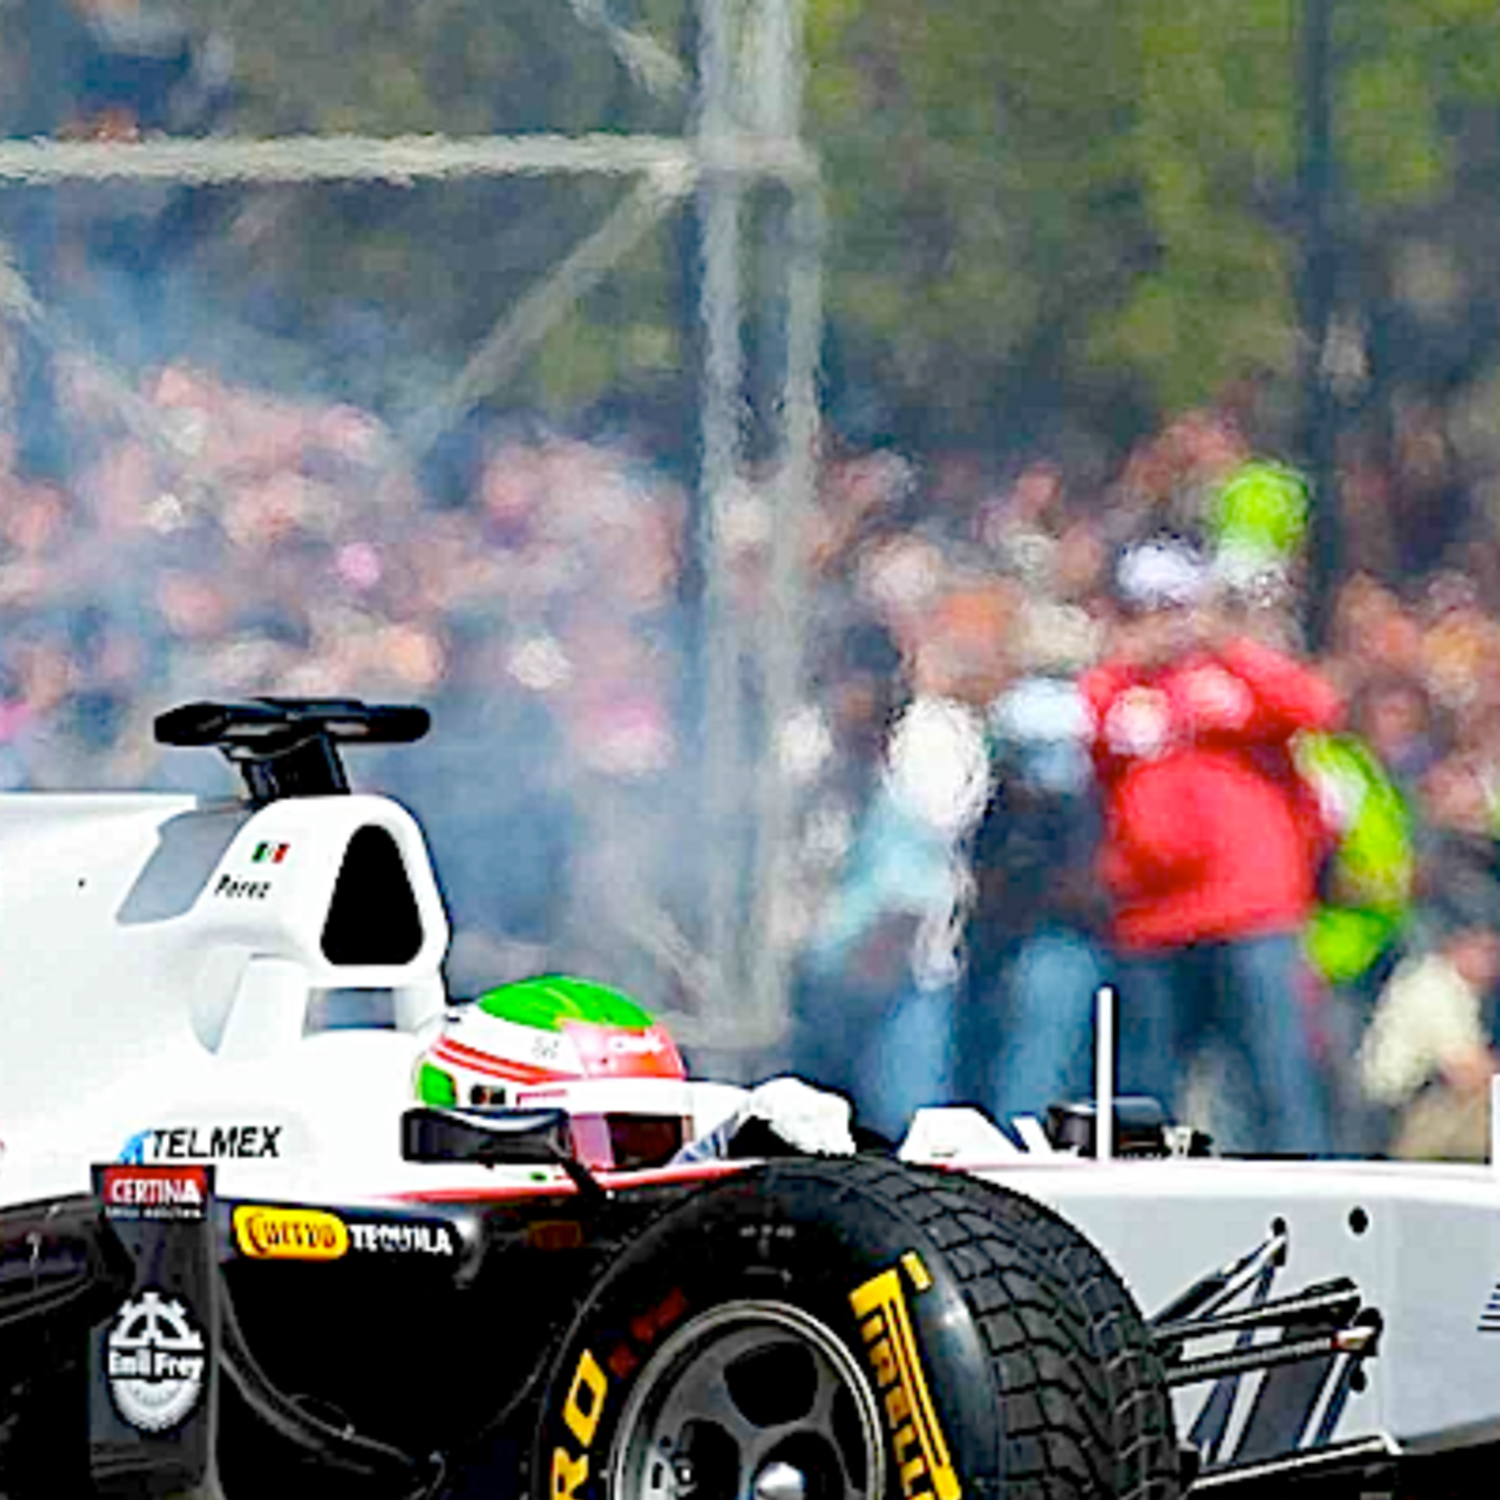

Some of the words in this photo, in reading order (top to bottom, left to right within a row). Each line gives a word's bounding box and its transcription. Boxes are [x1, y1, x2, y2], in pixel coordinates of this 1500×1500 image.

[152, 1127, 282, 1159] TELMEX
[111, 1178, 202, 1205] CERTINA
[350, 1223, 454, 1256] TEQUILA
